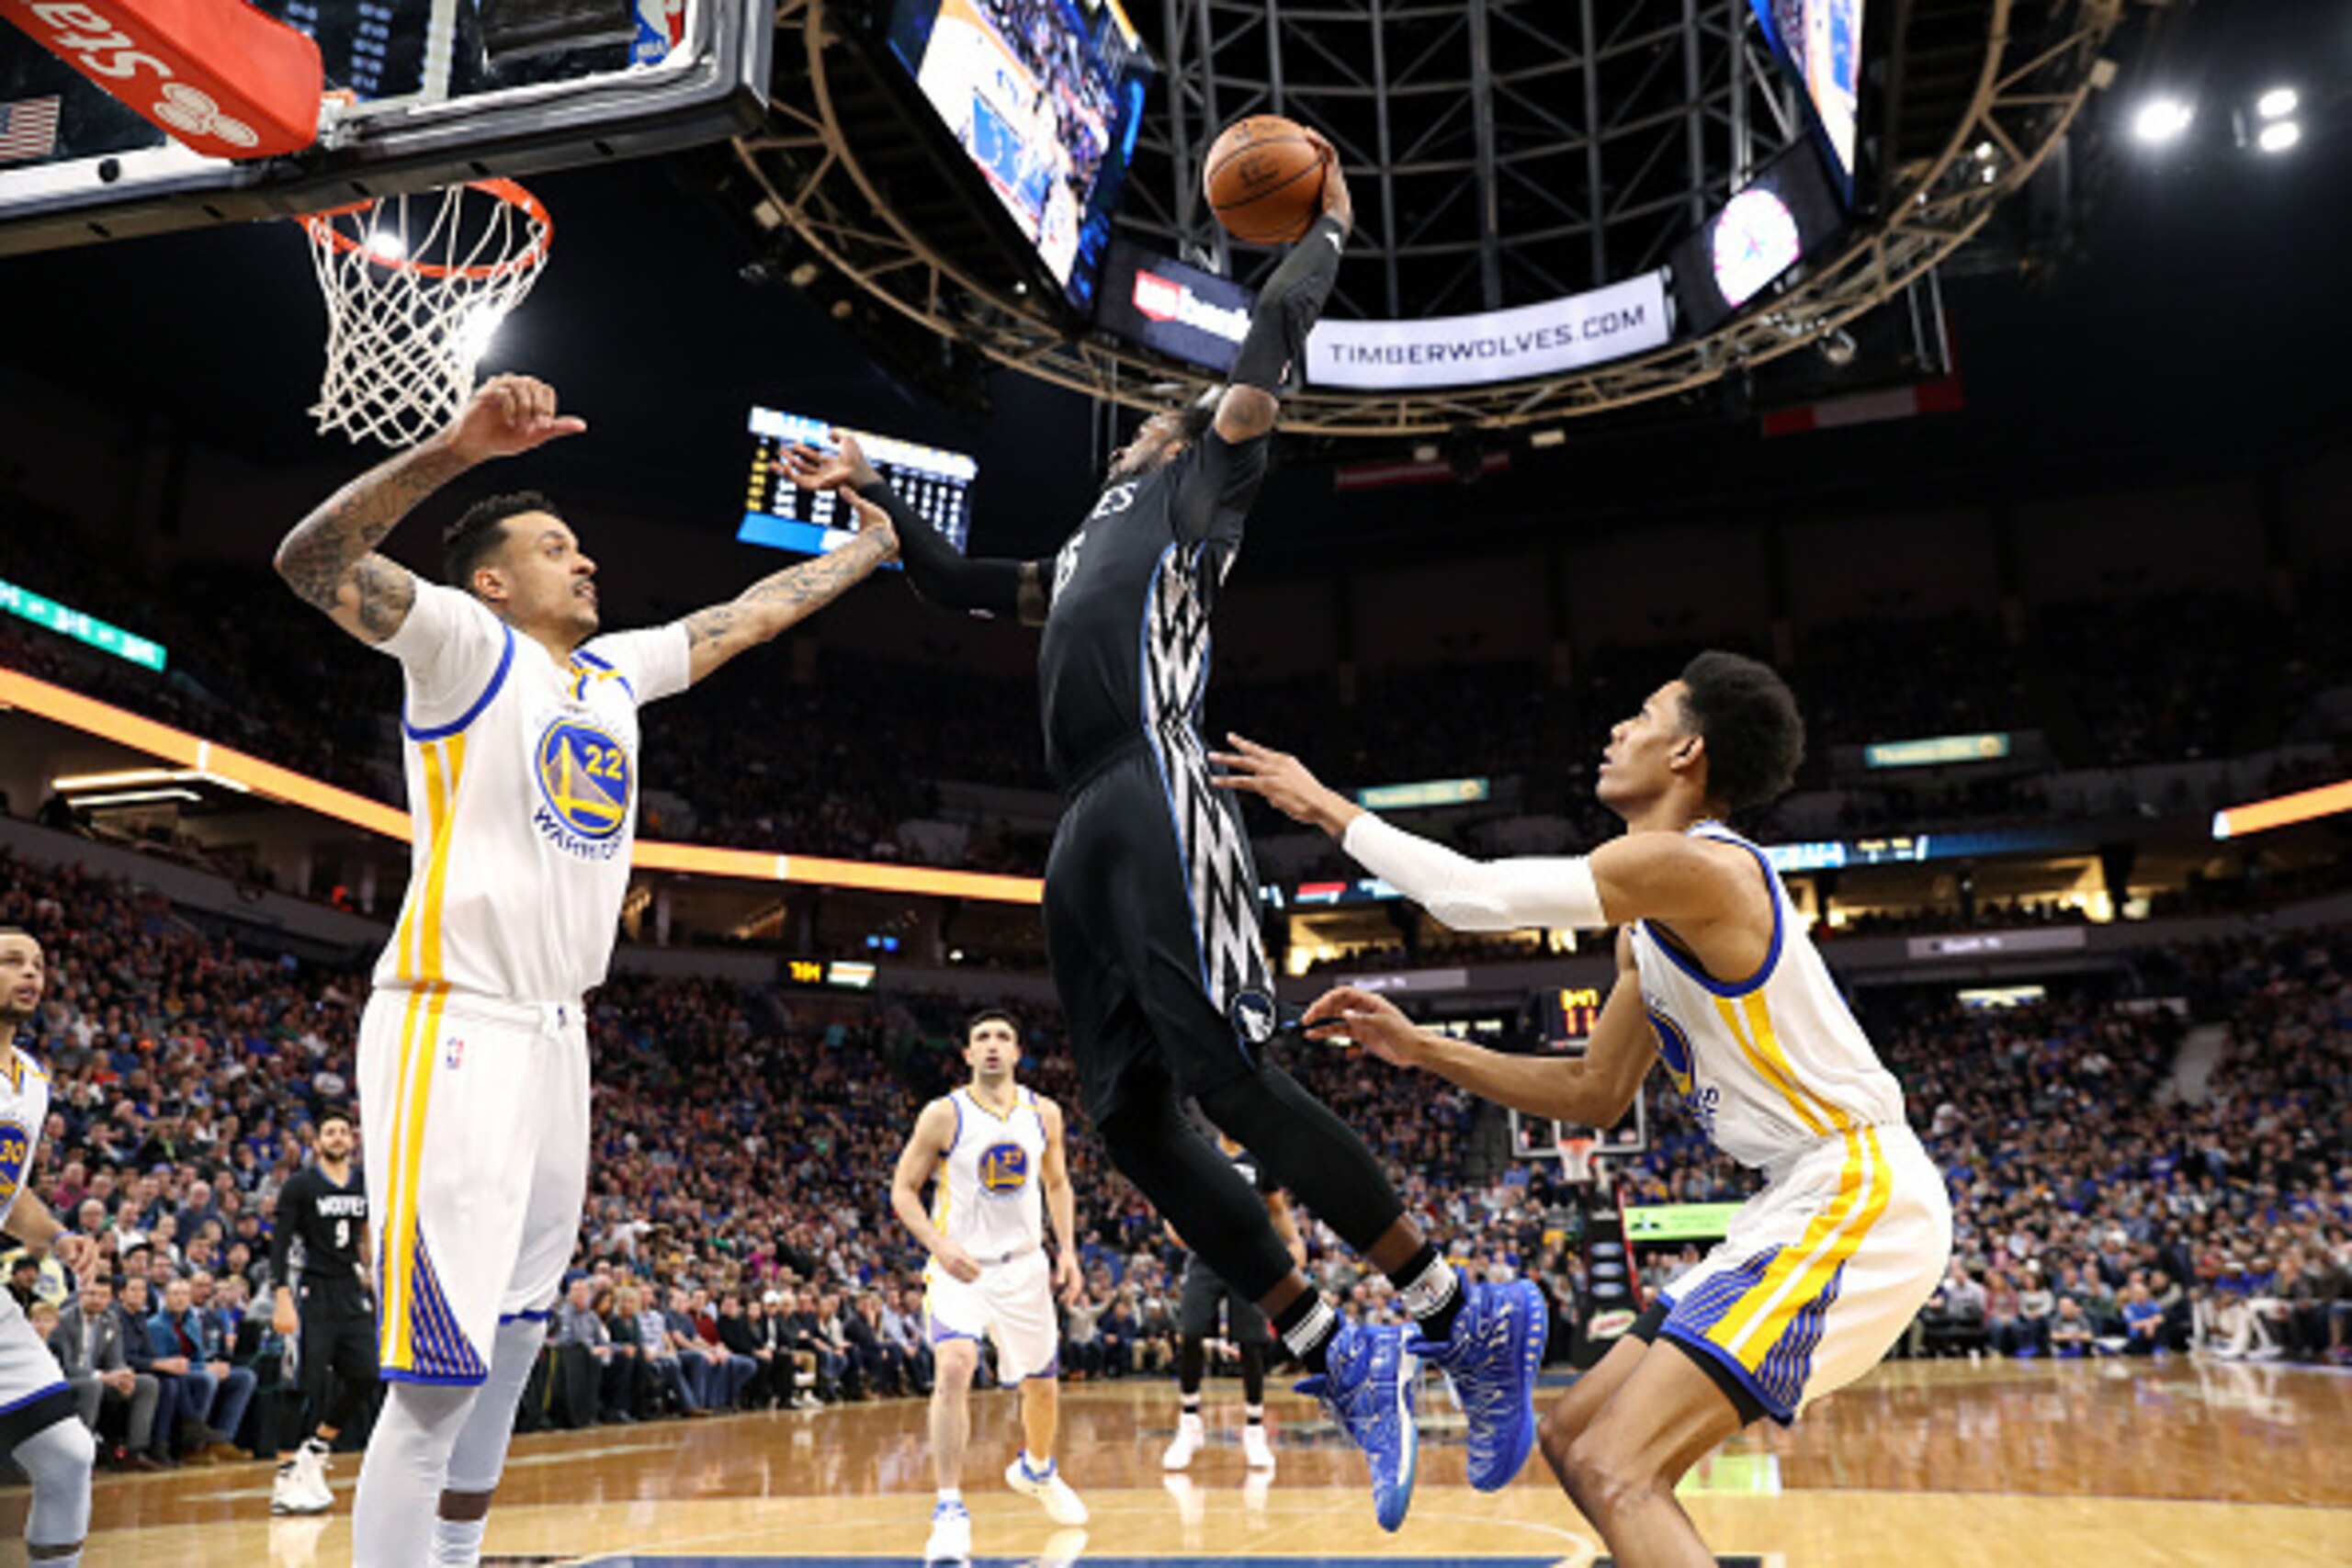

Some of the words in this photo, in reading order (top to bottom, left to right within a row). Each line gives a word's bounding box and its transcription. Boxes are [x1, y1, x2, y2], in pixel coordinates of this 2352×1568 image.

[18, 0, 174, 78] Sta
[1329, 305, 1645, 366] TIMBERWOLVES.COM
[585, 744, 624, 781] 22
[334, 1219, 350, 1248] 9
